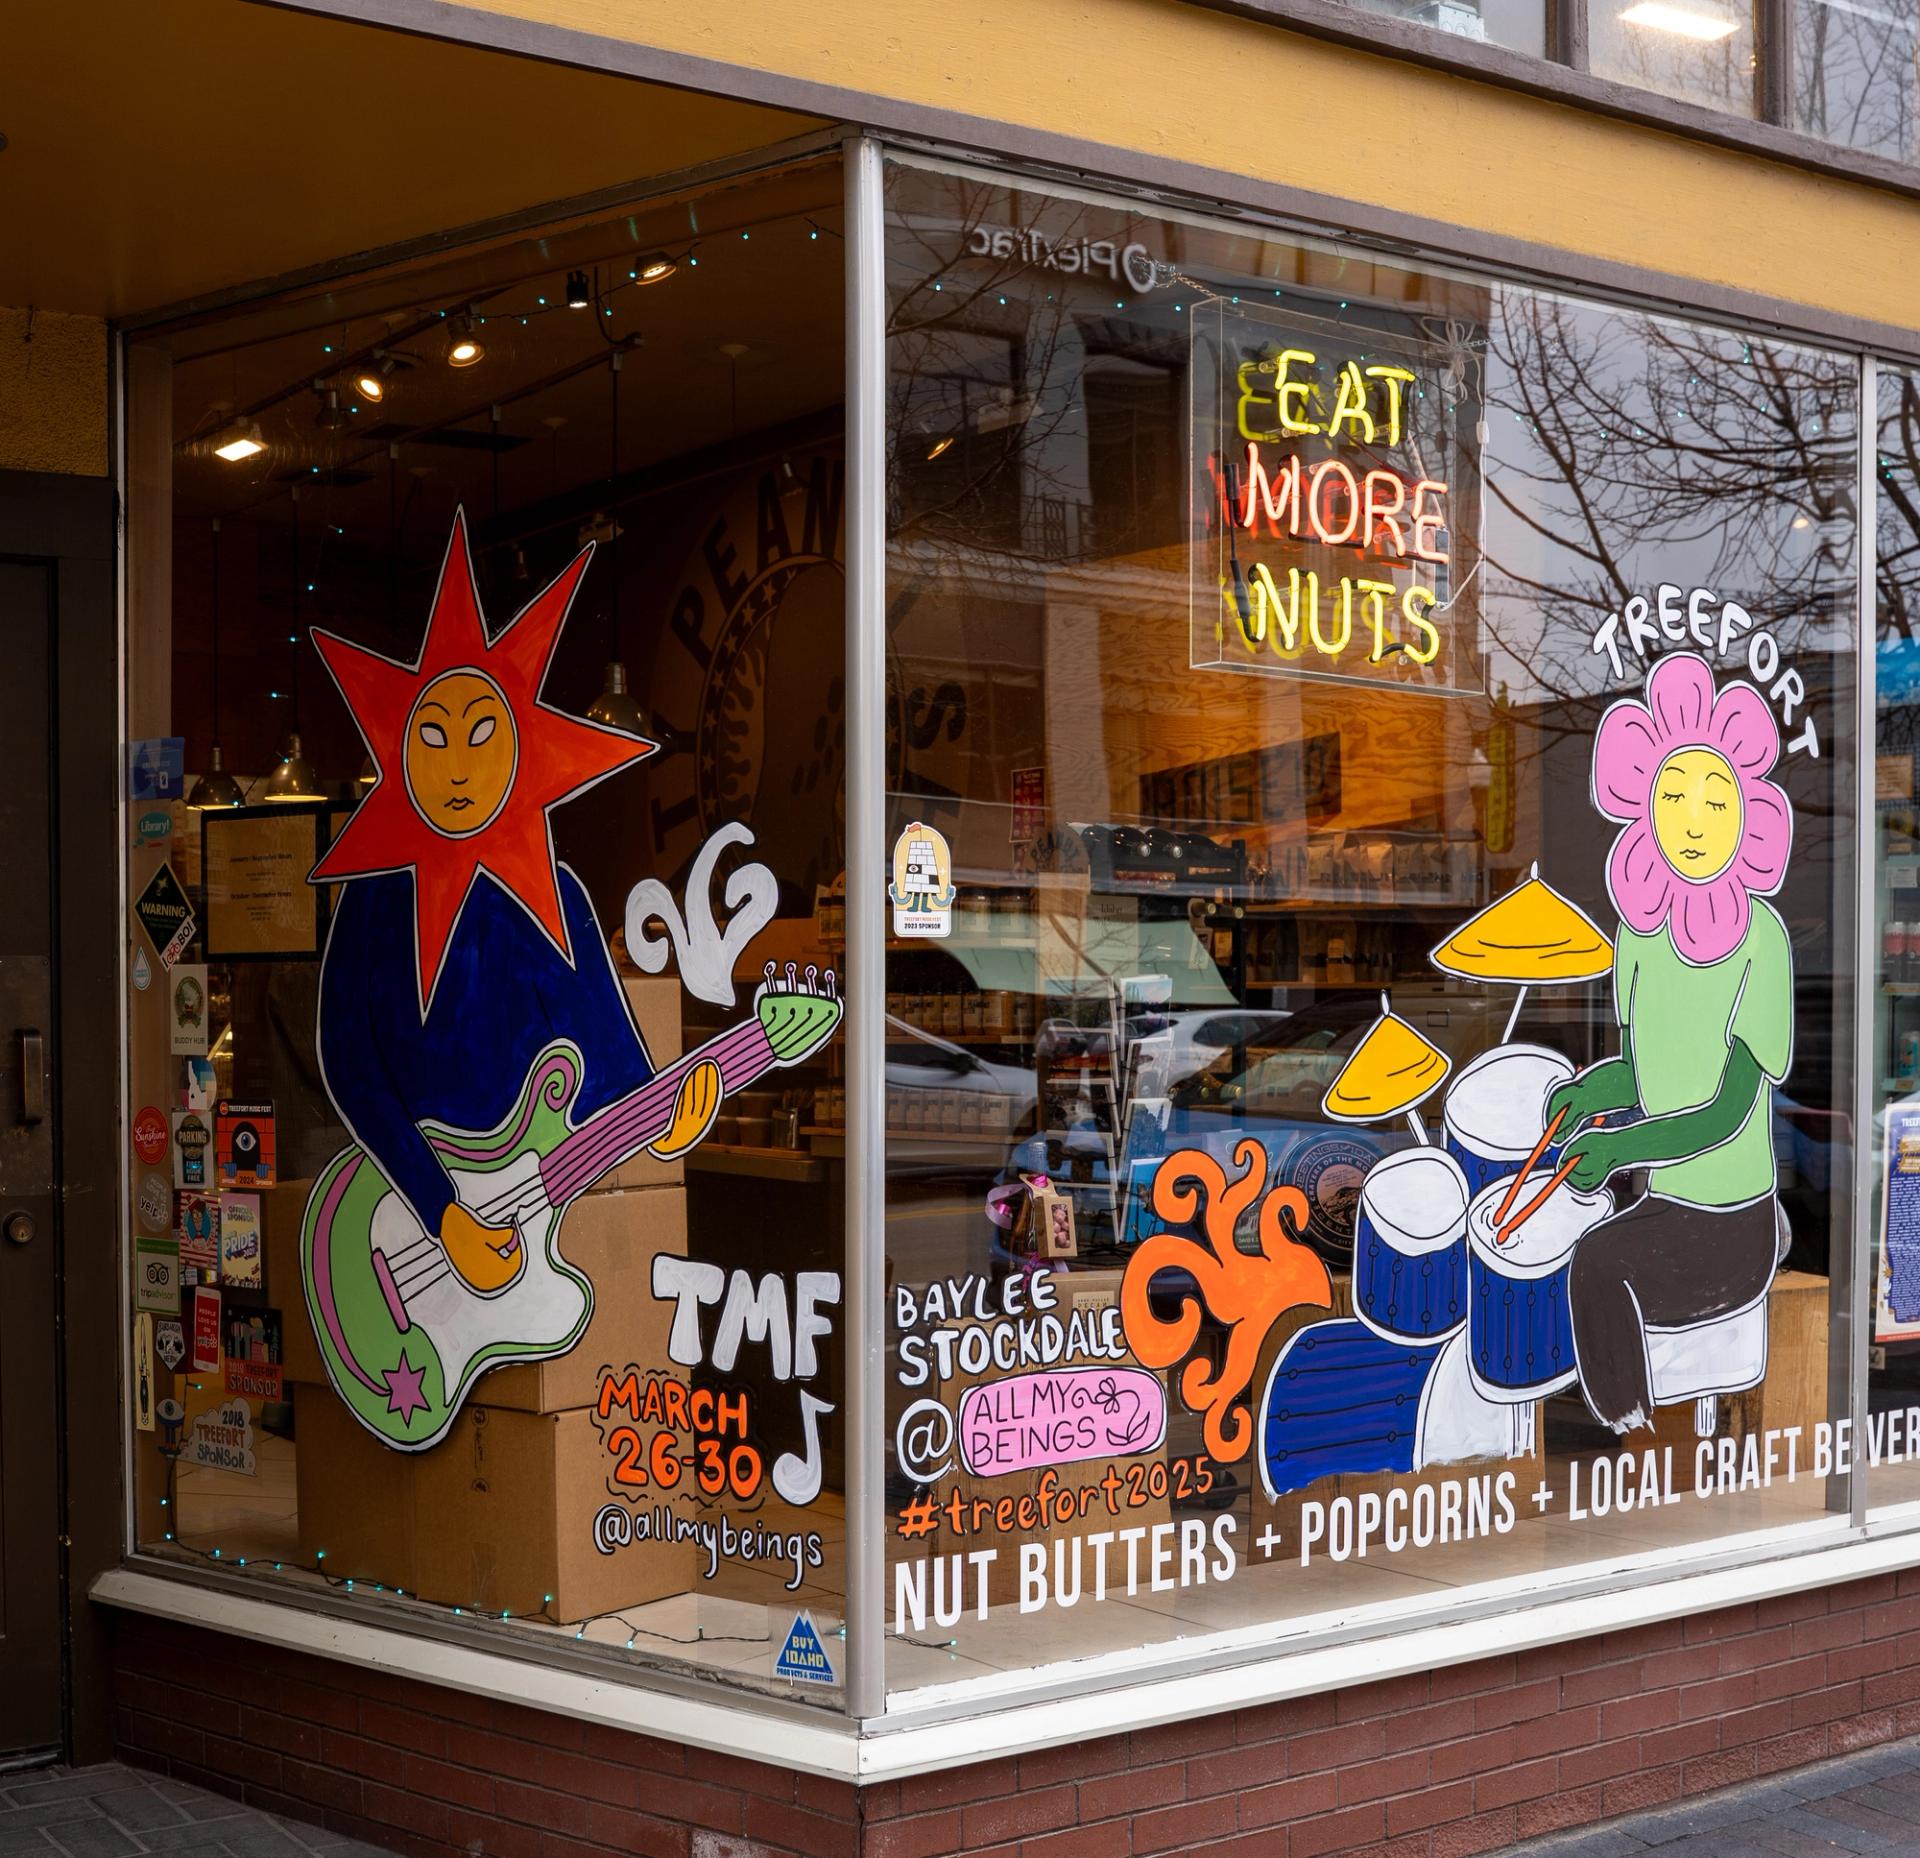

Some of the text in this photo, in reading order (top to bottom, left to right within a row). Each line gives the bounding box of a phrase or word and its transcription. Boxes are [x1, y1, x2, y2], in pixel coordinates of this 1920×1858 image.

[1274, 349, 1416, 448] EAT
[1243, 441, 1449, 565] MORE
[1254, 562, 1441, 666] NUTS
[1592, 582, 1820, 759] TREEFORT
[141, 902, 186, 918] WARNING
[177, 922, 193, 945] BOI
[174, 1036, 193, 1046] BUDDY
[261, 1105, 272, 1113] FEST
[178, 1131, 207, 1145] PARKING
[1336, 1156, 1353, 1164] THE
[239, 1175, 254, 1185] 2024
[140, 1196, 158, 1217] yelp
[224, 1232, 256, 1254] PRIDE
[140, 1287, 175, 1300] tripadvisor
[896, 1268, 1058, 1330] BAYLEE
[652, 1252, 841, 1381] TMF
[897, 1306, 1128, 1387] STOCKDALE
[229, 1374, 278, 1397] SPONSOR
[597, 1372, 748, 1440] MARCH
[973, 1386, 1026, 1425] ALL
[1031, 1378, 1076, 1418] MY
[222, 1410, 245, 1428] 2018
[197, 1423, 246, 1448] TREEFORT
[972, 1416, 1096, 1468] BEINGS
[606, 1426, 763, 1501] 26-30
[897, 1456, 1214, 1540] #treefort2025
[895, 1549, 997, 1634] NUT
[1020, 1513, 1238, 1615] BUTTERS
[1301, 1471, 1516, 1568] POPCORNS
[1569, 1447, 1681, 1521] LOCAL
[1695, 1427, 1802, 1499] CRAFT
[592, 1503, 824, 1592] @allmybeings
[792, 1635, 815, 1649] BUY
[784, 1650, 824, 1668] IDAHO
[808, 1671, 834, 1683] SERVICES
